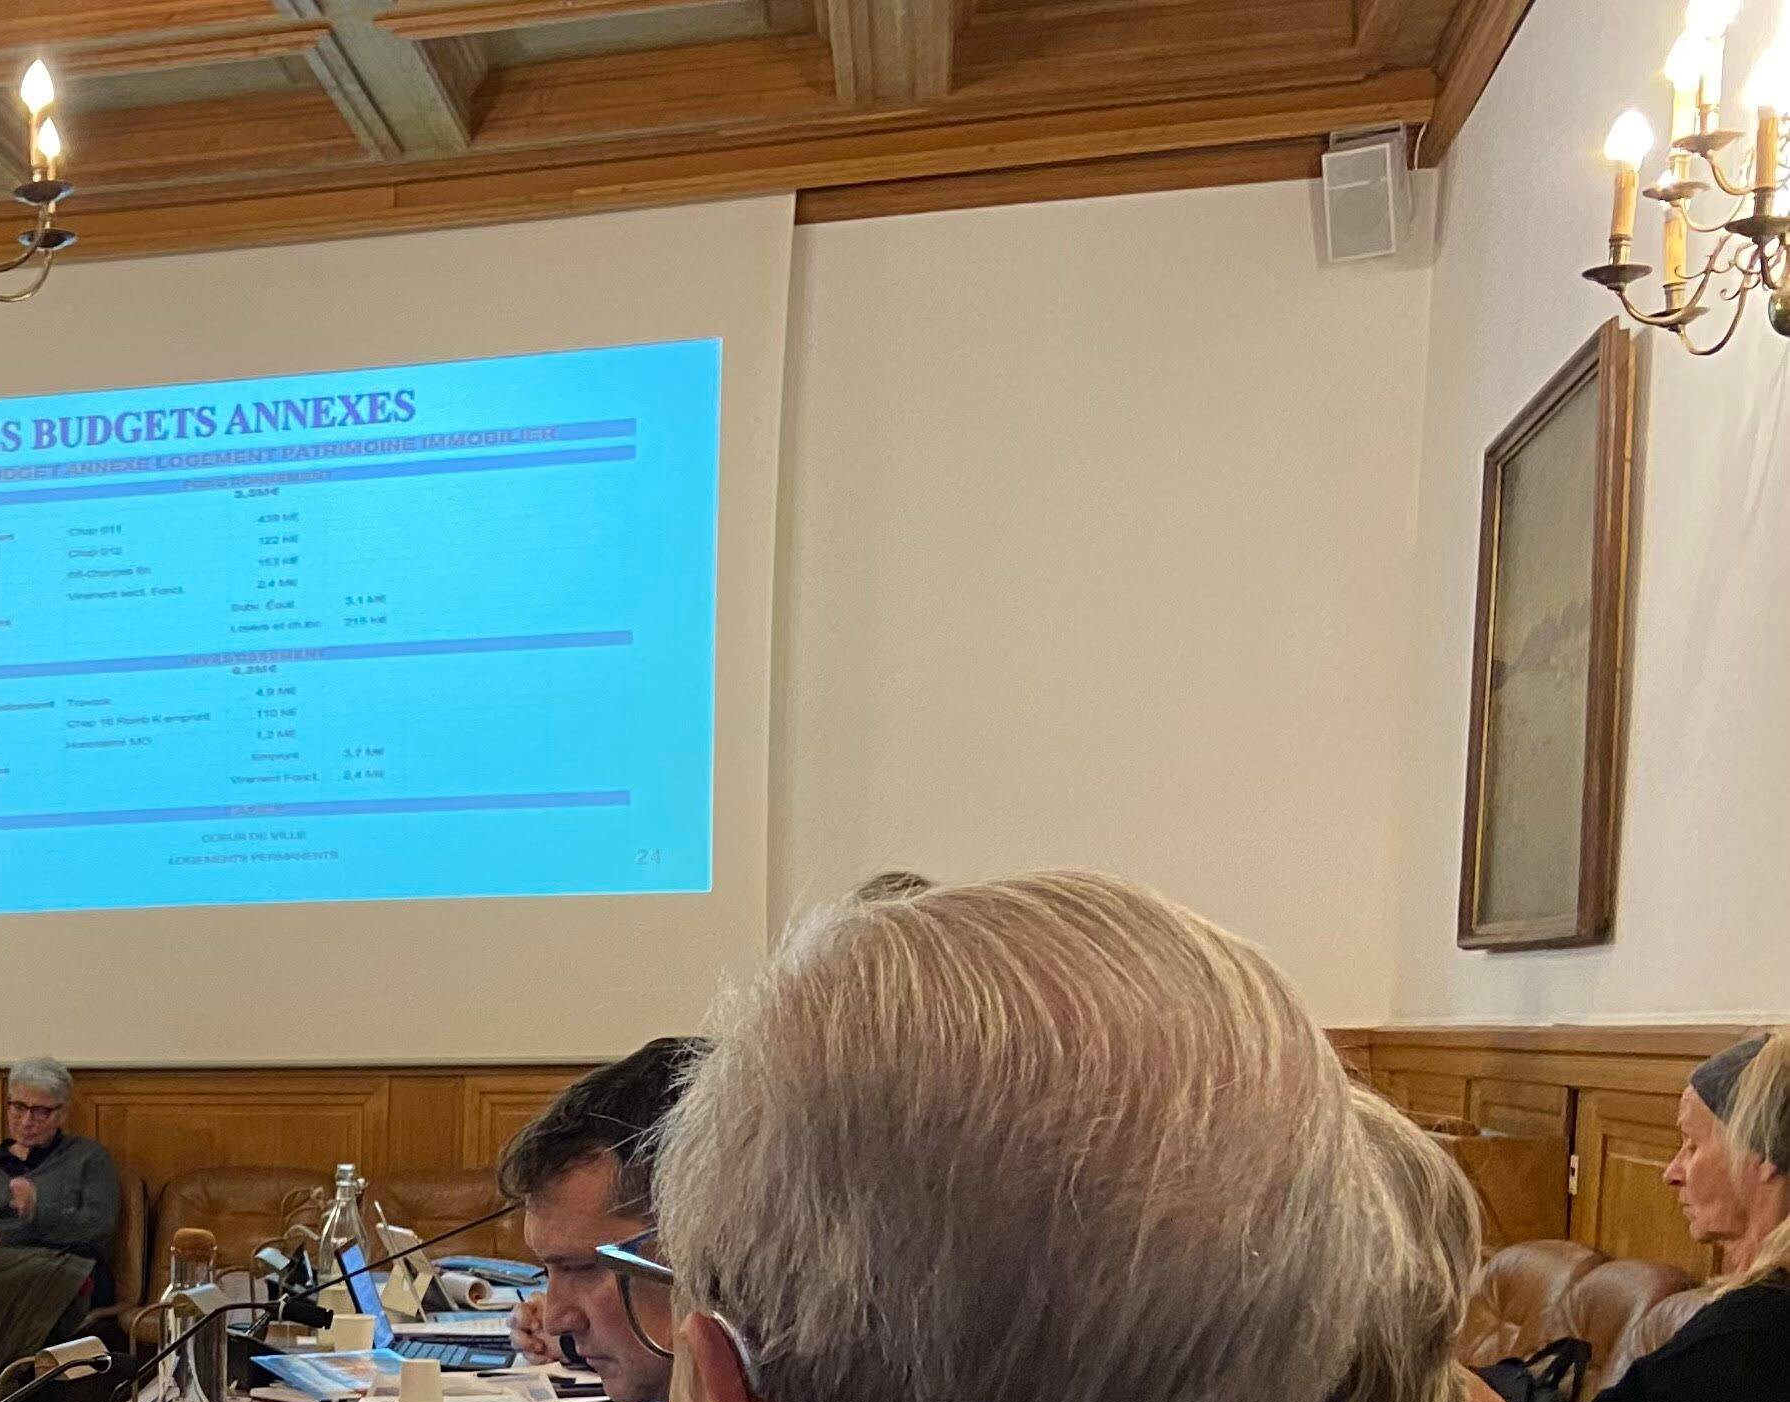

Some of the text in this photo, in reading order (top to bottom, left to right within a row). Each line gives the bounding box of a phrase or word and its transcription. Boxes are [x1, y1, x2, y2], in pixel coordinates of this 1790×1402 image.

[32, 405, 218, 450] BUDGETS
[224, 389, 417, 435] ANNEXES
[66, 457, 150, 476] ANNEXE
[157, 448, 278, 470] LOGEMENT
[282, 437, 415, 460] PATRIMOINE
[422, 426, 559, 449] IMMOBILIER
